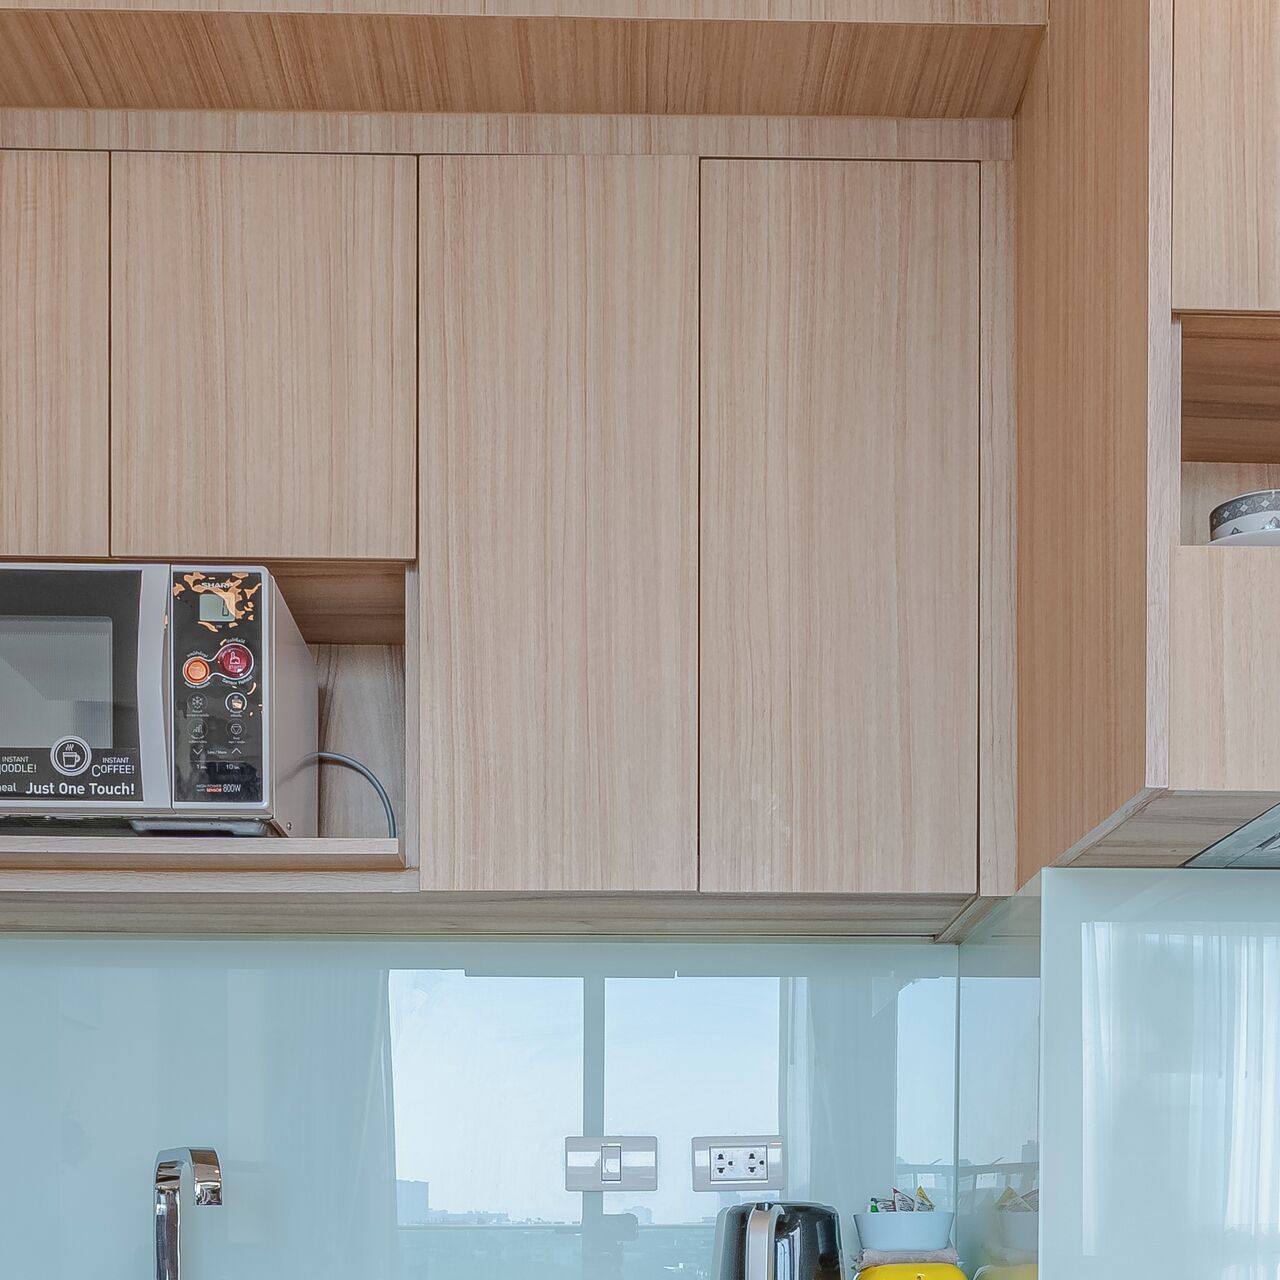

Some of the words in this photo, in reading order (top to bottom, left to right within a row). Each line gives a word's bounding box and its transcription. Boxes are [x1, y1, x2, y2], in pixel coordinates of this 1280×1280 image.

[91, 764, 135, 778] COFFEE!
[25, 782, 55, 795] Just
[58, 783, 85, 795] One
[88, 783, 135, 795] Touch!
